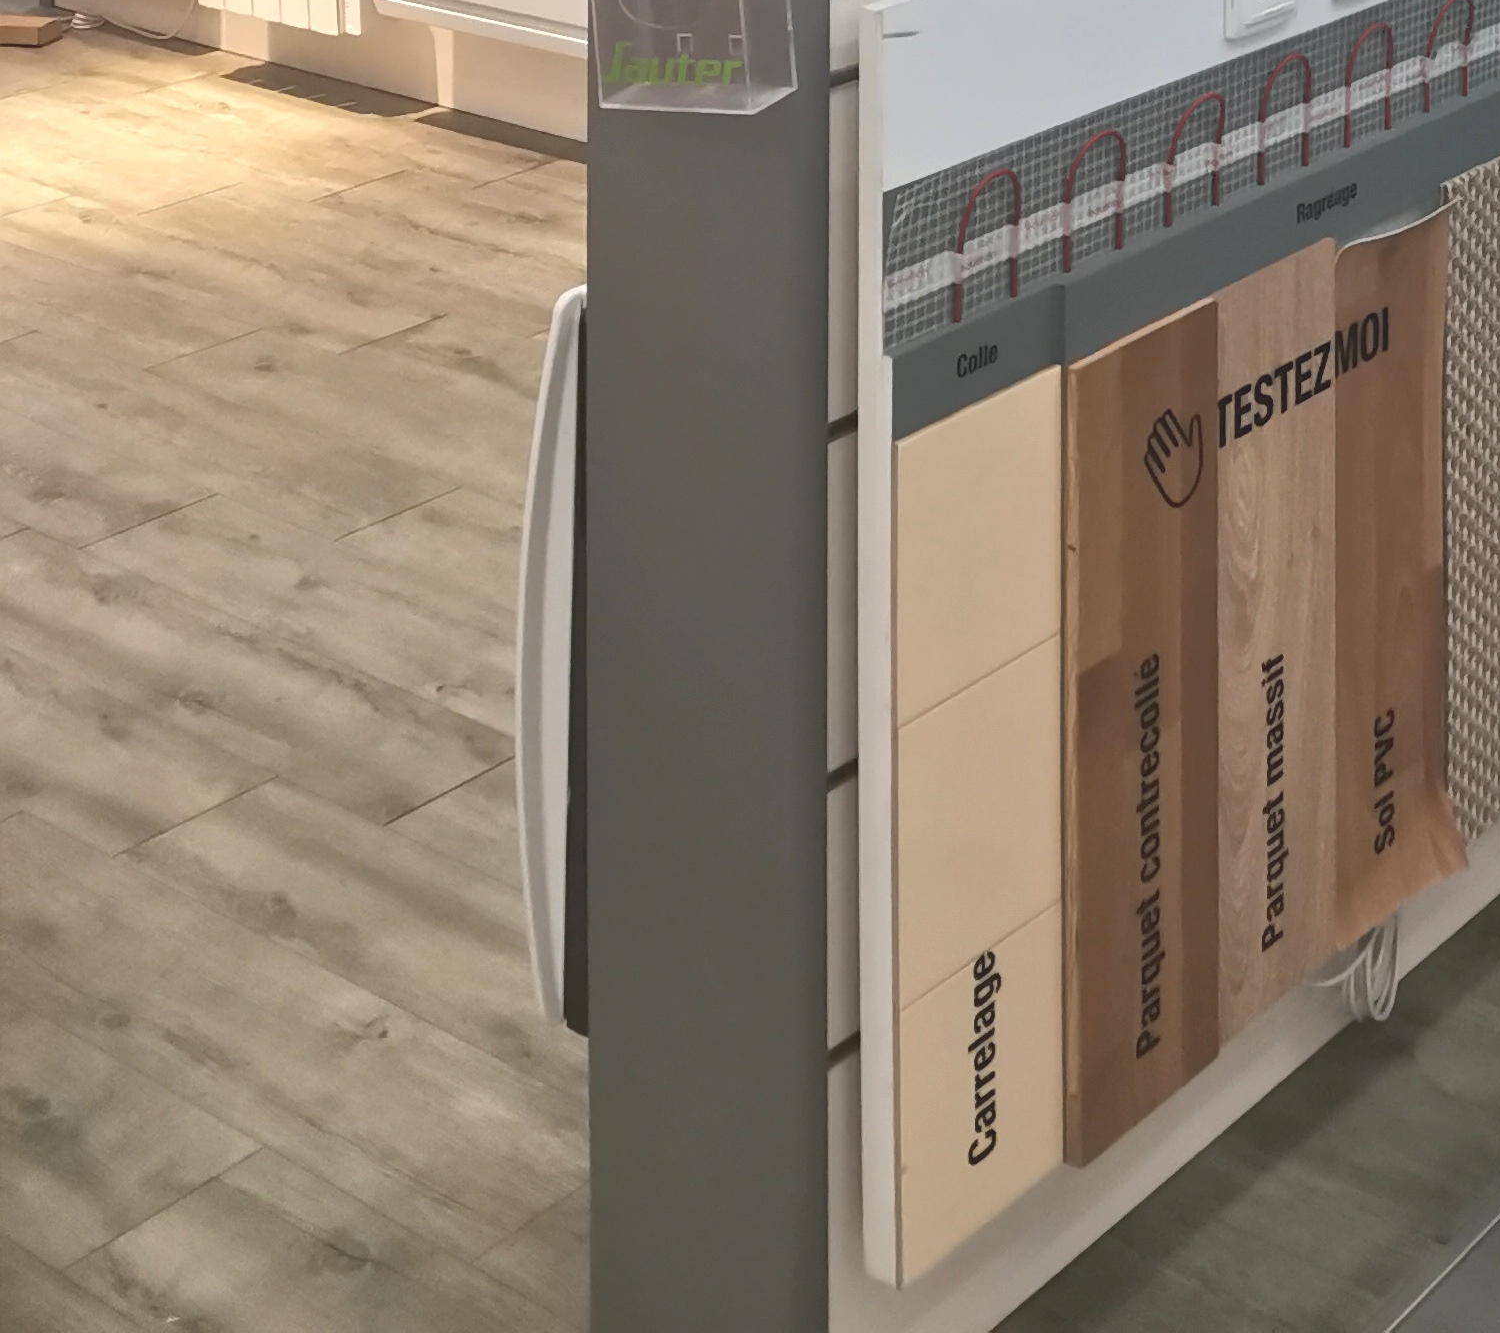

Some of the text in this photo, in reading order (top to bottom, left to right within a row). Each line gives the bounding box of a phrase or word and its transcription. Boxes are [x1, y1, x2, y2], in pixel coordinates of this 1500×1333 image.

[956, 343, 998, 378] Colle
[1216, 306, 1389, 449] TESTEZ MOI
[1132, 652, 1166, 1060] Parquet contrecollé
[1260, 652, 1290, 953] Parquet massif
[1373, 707, 1395, 855] Sol PVC
[966, 949, 1002, 1167] Carrelage
